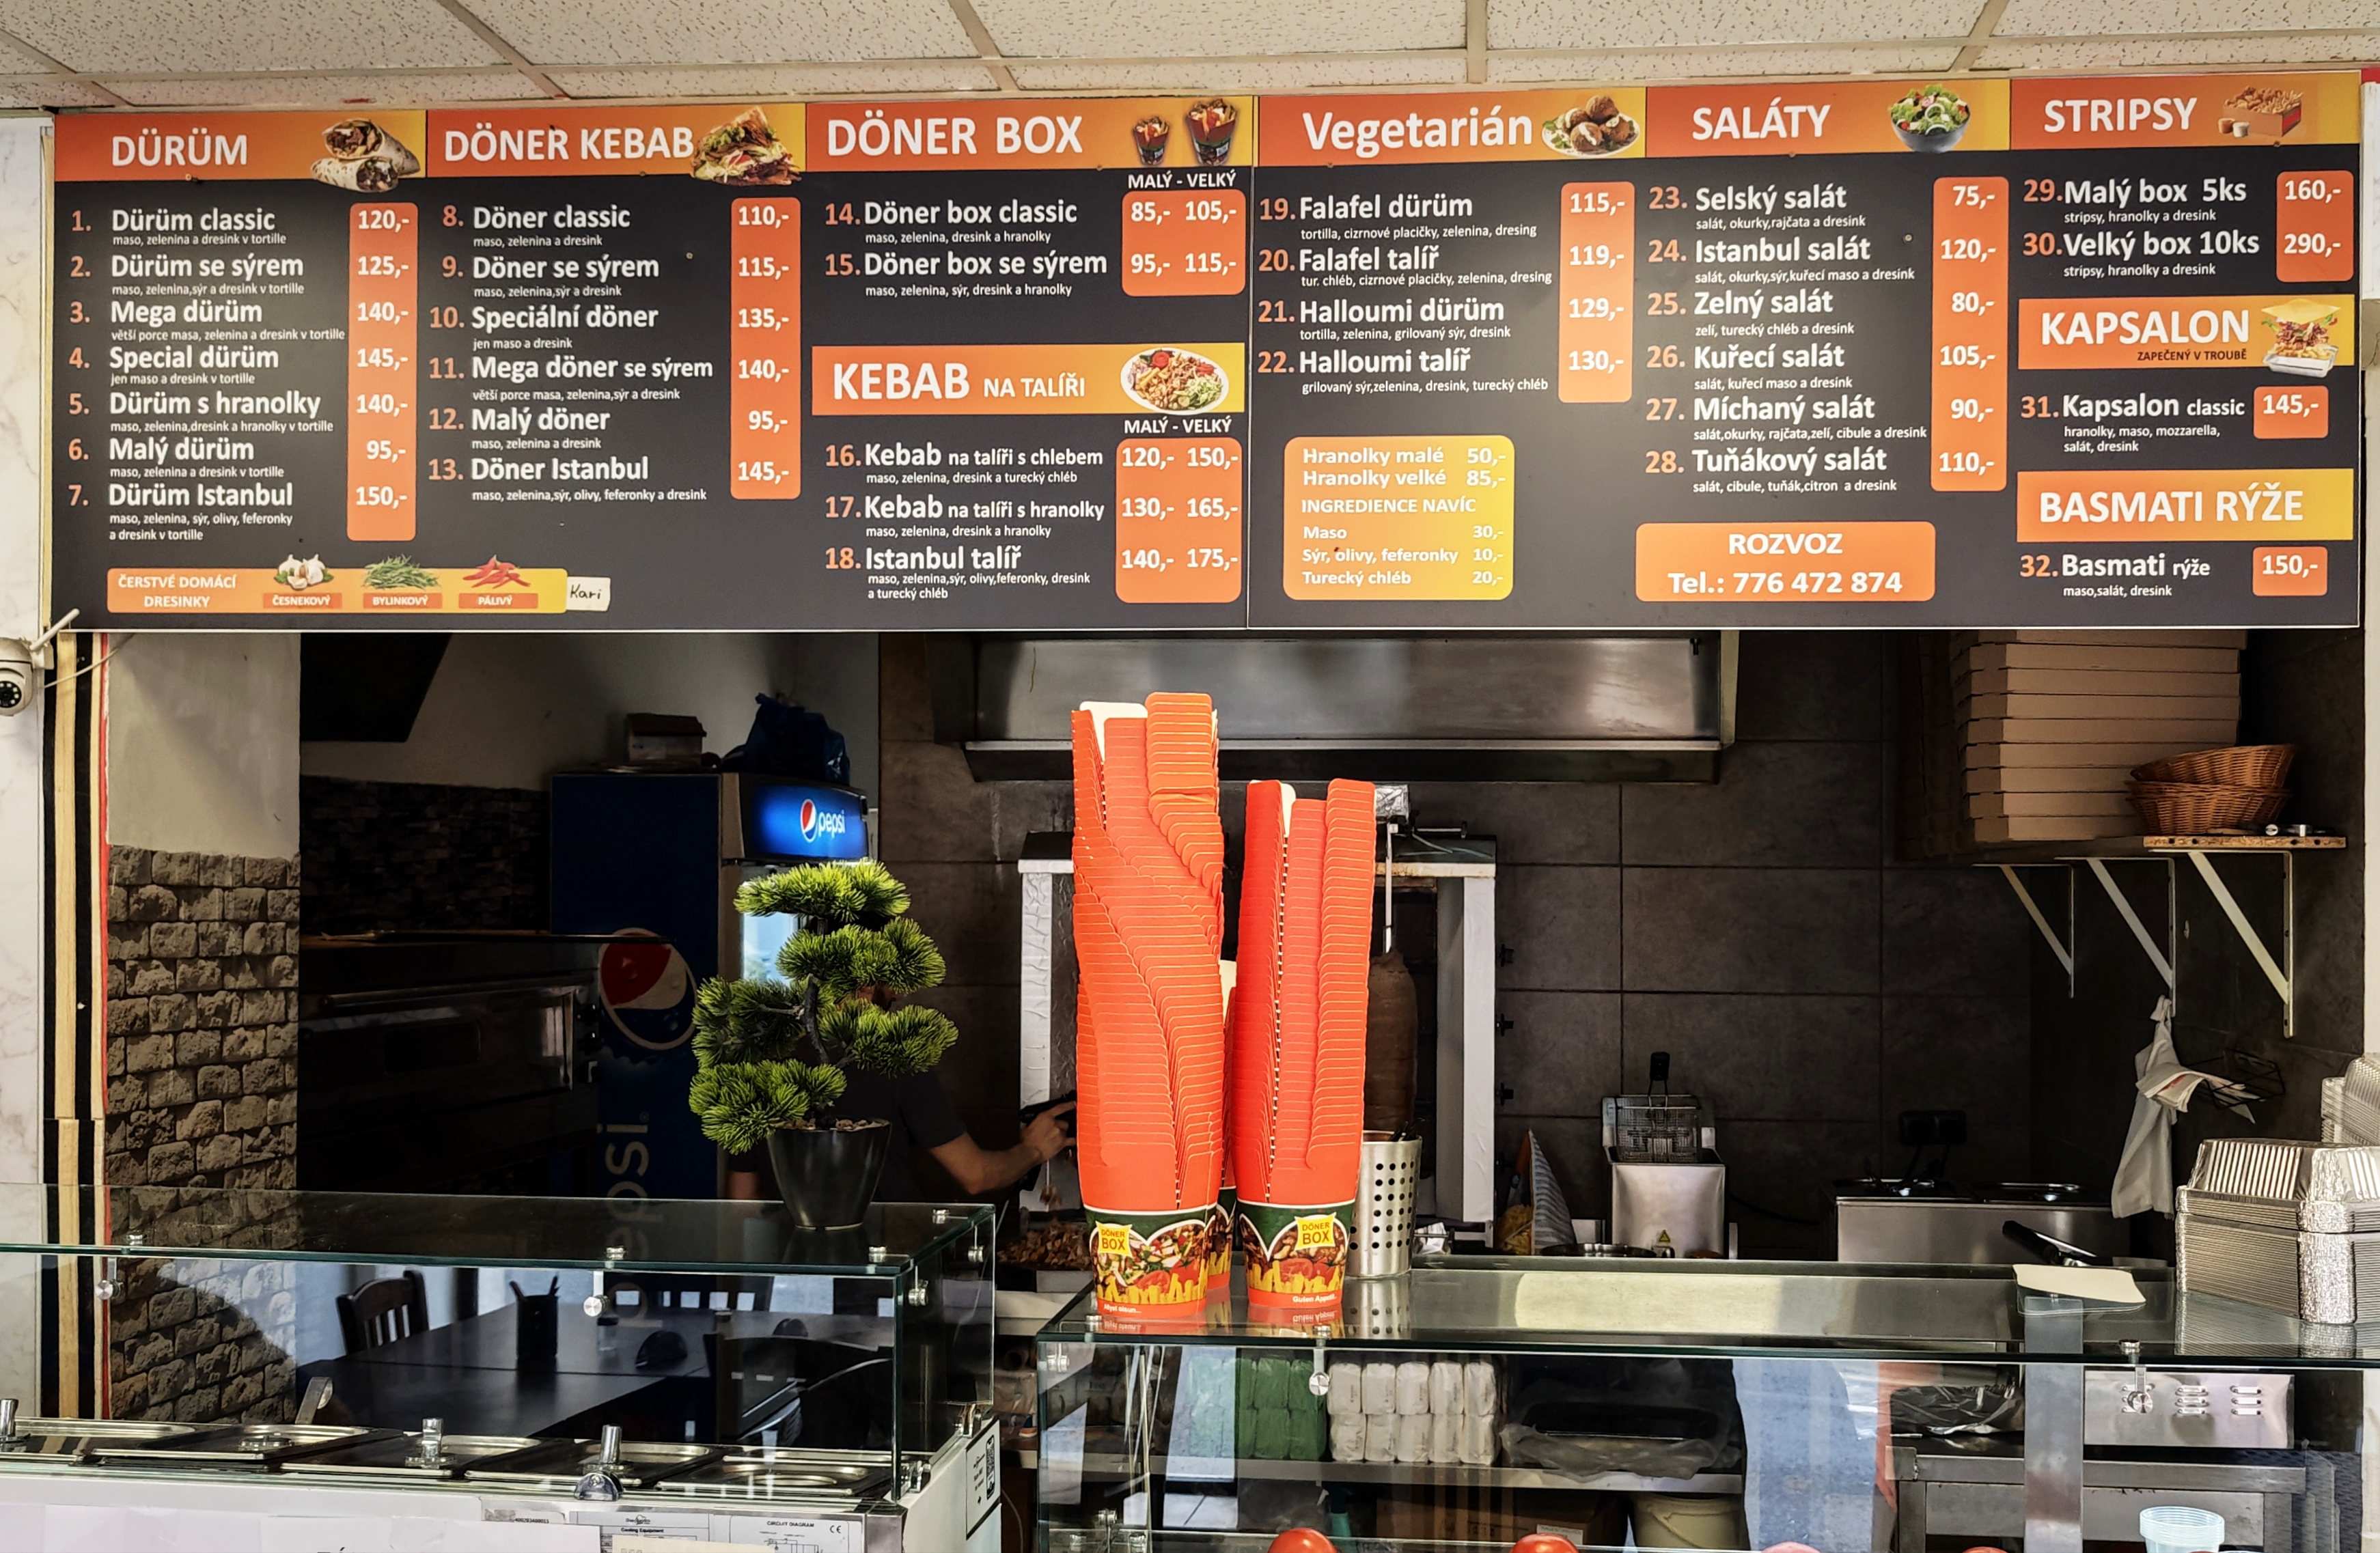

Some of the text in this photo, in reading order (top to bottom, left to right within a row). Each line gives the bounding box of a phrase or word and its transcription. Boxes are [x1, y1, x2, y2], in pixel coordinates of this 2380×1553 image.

[1692, 96, 1831, 141] SALÁTY
[2044, 97, 2198, 133] STRIPSY
[828, 109, 1083, 156] DÖNER BOX
[1302, 104, 1532, 158] Vegetarián
[112, 127, 247, 167] DÜRÜM
[445, 122, 694, 162] DÖNER KEBAB
[1128, 168, 1236, 189] MALÝ VELKÝ
[1648, 182, 1995, 215] 23. Selský salát 75,-
[2023, 176, 2341, 209] 29. Malý box 5ks 160,-
[442, 204, 790, 229] 8. Döner classic 110,-
[825, 198, 1237, 225] 14. Döner box classic 85,- 105,-
[1260, 192, 1626, 221] 19. Falafel dürüm 115,-
[2064, 208, 2217, 225] stripsy, hranolky a dresink
[72, 207, 410, 233] 1. Dürüm classic 120,-
[112, 232, 287, 247] maso, zelenina a dresink v tortille
[865, 229, 1051, 245] maso, zelenina, dresink a hranolky
[1300, 223, 1538, 241] tortilla, cizrnové placičky, zelenina, dresing
[1694, 270, 1726, 285] salát,
[1827, 270, 1860, 281] maso
[1862, 270, 1870, 281] a
[1872, 267, 1915, 280] dresink
[2042, 309, 2249, 346] KAPSALON
[1299, 346, 1624, 374] Halloumi talíř 130,-
[2137, 348, 2247, 361] ZAPEČENÝ V TROUBĚ
[833, 363, 1085, 400] KEBAB NA TALÍŘI
[2062, 393, 2319, 423] Kapsalon classic 145,-
[1124, 415, 1232, 434] MALÝ VELKÝ
[865, 441, 1239, 471] Kebab na talíři s chlebem 120,- 150,-
[1303, 446, 1506, 467] Hranolky malé 50,-
[1691, 445, 1995, 477] Tuňákový salát 110,-
[471, 456, 790, 485] Döner Istanbul 145,-
[109, 481, 408, 509] Dürüm Istanbul 150,-
[1693, 479, 1724, 494] salát,
[1726, 479, 1765, 494] cibule,
[1844, 481, 1852, 492] a
[1853, 479, 1897, 492] dresink
[1301, 495, 1476, 514] INGREDIENCE NAVÍC
[2040, 481, 2303, 523] BASMATI RÝŽE
[109, 512, 293, 527] maso, zelenina, sýr, olivy, feferonky
[109, 528, 204, 541] a dresink v tortille
[1728, 533, 1843, 555] ROZVOZ
[1301, 547, 1504, 565] Sýr, olivy, feferonky 10,-
[2062, 552, 2319, 580] Basmati rýže 150,-
[117, 573, 237, 589] ČERSTVÉ DOMÁCÍ
[570, 583, 601, 600] Kari
[1667, 571, 1903, 594] Tel.: 776 472 874
[2129, 584, 2172, 596] dresink
[143, 595, 210, 608] DRESINKY
[271, 594, 331, 606] ČESNEKOVÝ
[372, 594, 429, 606] BYLINKOVÝ
[478, 594, 513, 606] PÁLIVÝ
[818, 809, 846, 839] pepsi
[1101, 1227, 1126, 1238] DÖNER
[1301, 1221, 1331, 1231] DÖNER
[1101, 1237, 1126, 1251] BOX
[1302, 1231, 1329, 1246] BOX
